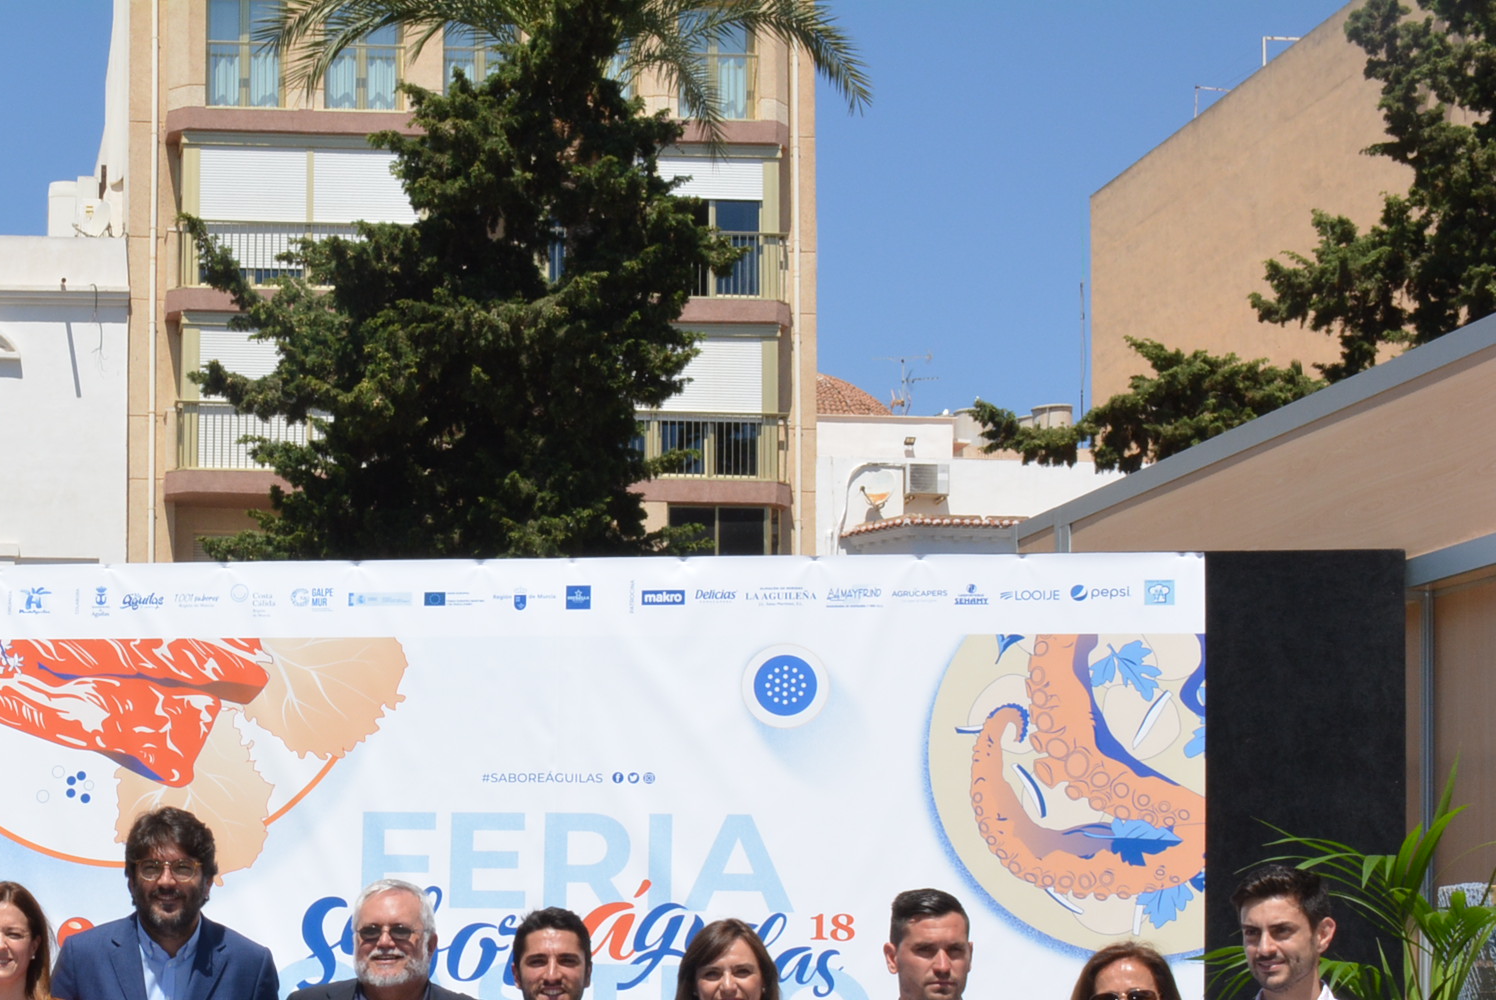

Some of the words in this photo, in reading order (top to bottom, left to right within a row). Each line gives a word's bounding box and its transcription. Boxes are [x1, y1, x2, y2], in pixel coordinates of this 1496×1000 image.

[311, 588, 333, 597] GALPE
[644, 591, 682, 603] makro
[695, 589, 736, 600] Delicias
[745, 591, 759, 600] LA
[761, 589, 817, 600] AGUILEÑA
[1015, 590, 1060, 601] LOOIJE
[1091, 586, 1130, 600] pepsi
[311, 598, 327, 607] MUR
[482, 771, 603, 784] #SABOREÁGUILAS
[361, 810, 795, 913] FERIA
[810, 913, 855, 942] 18
